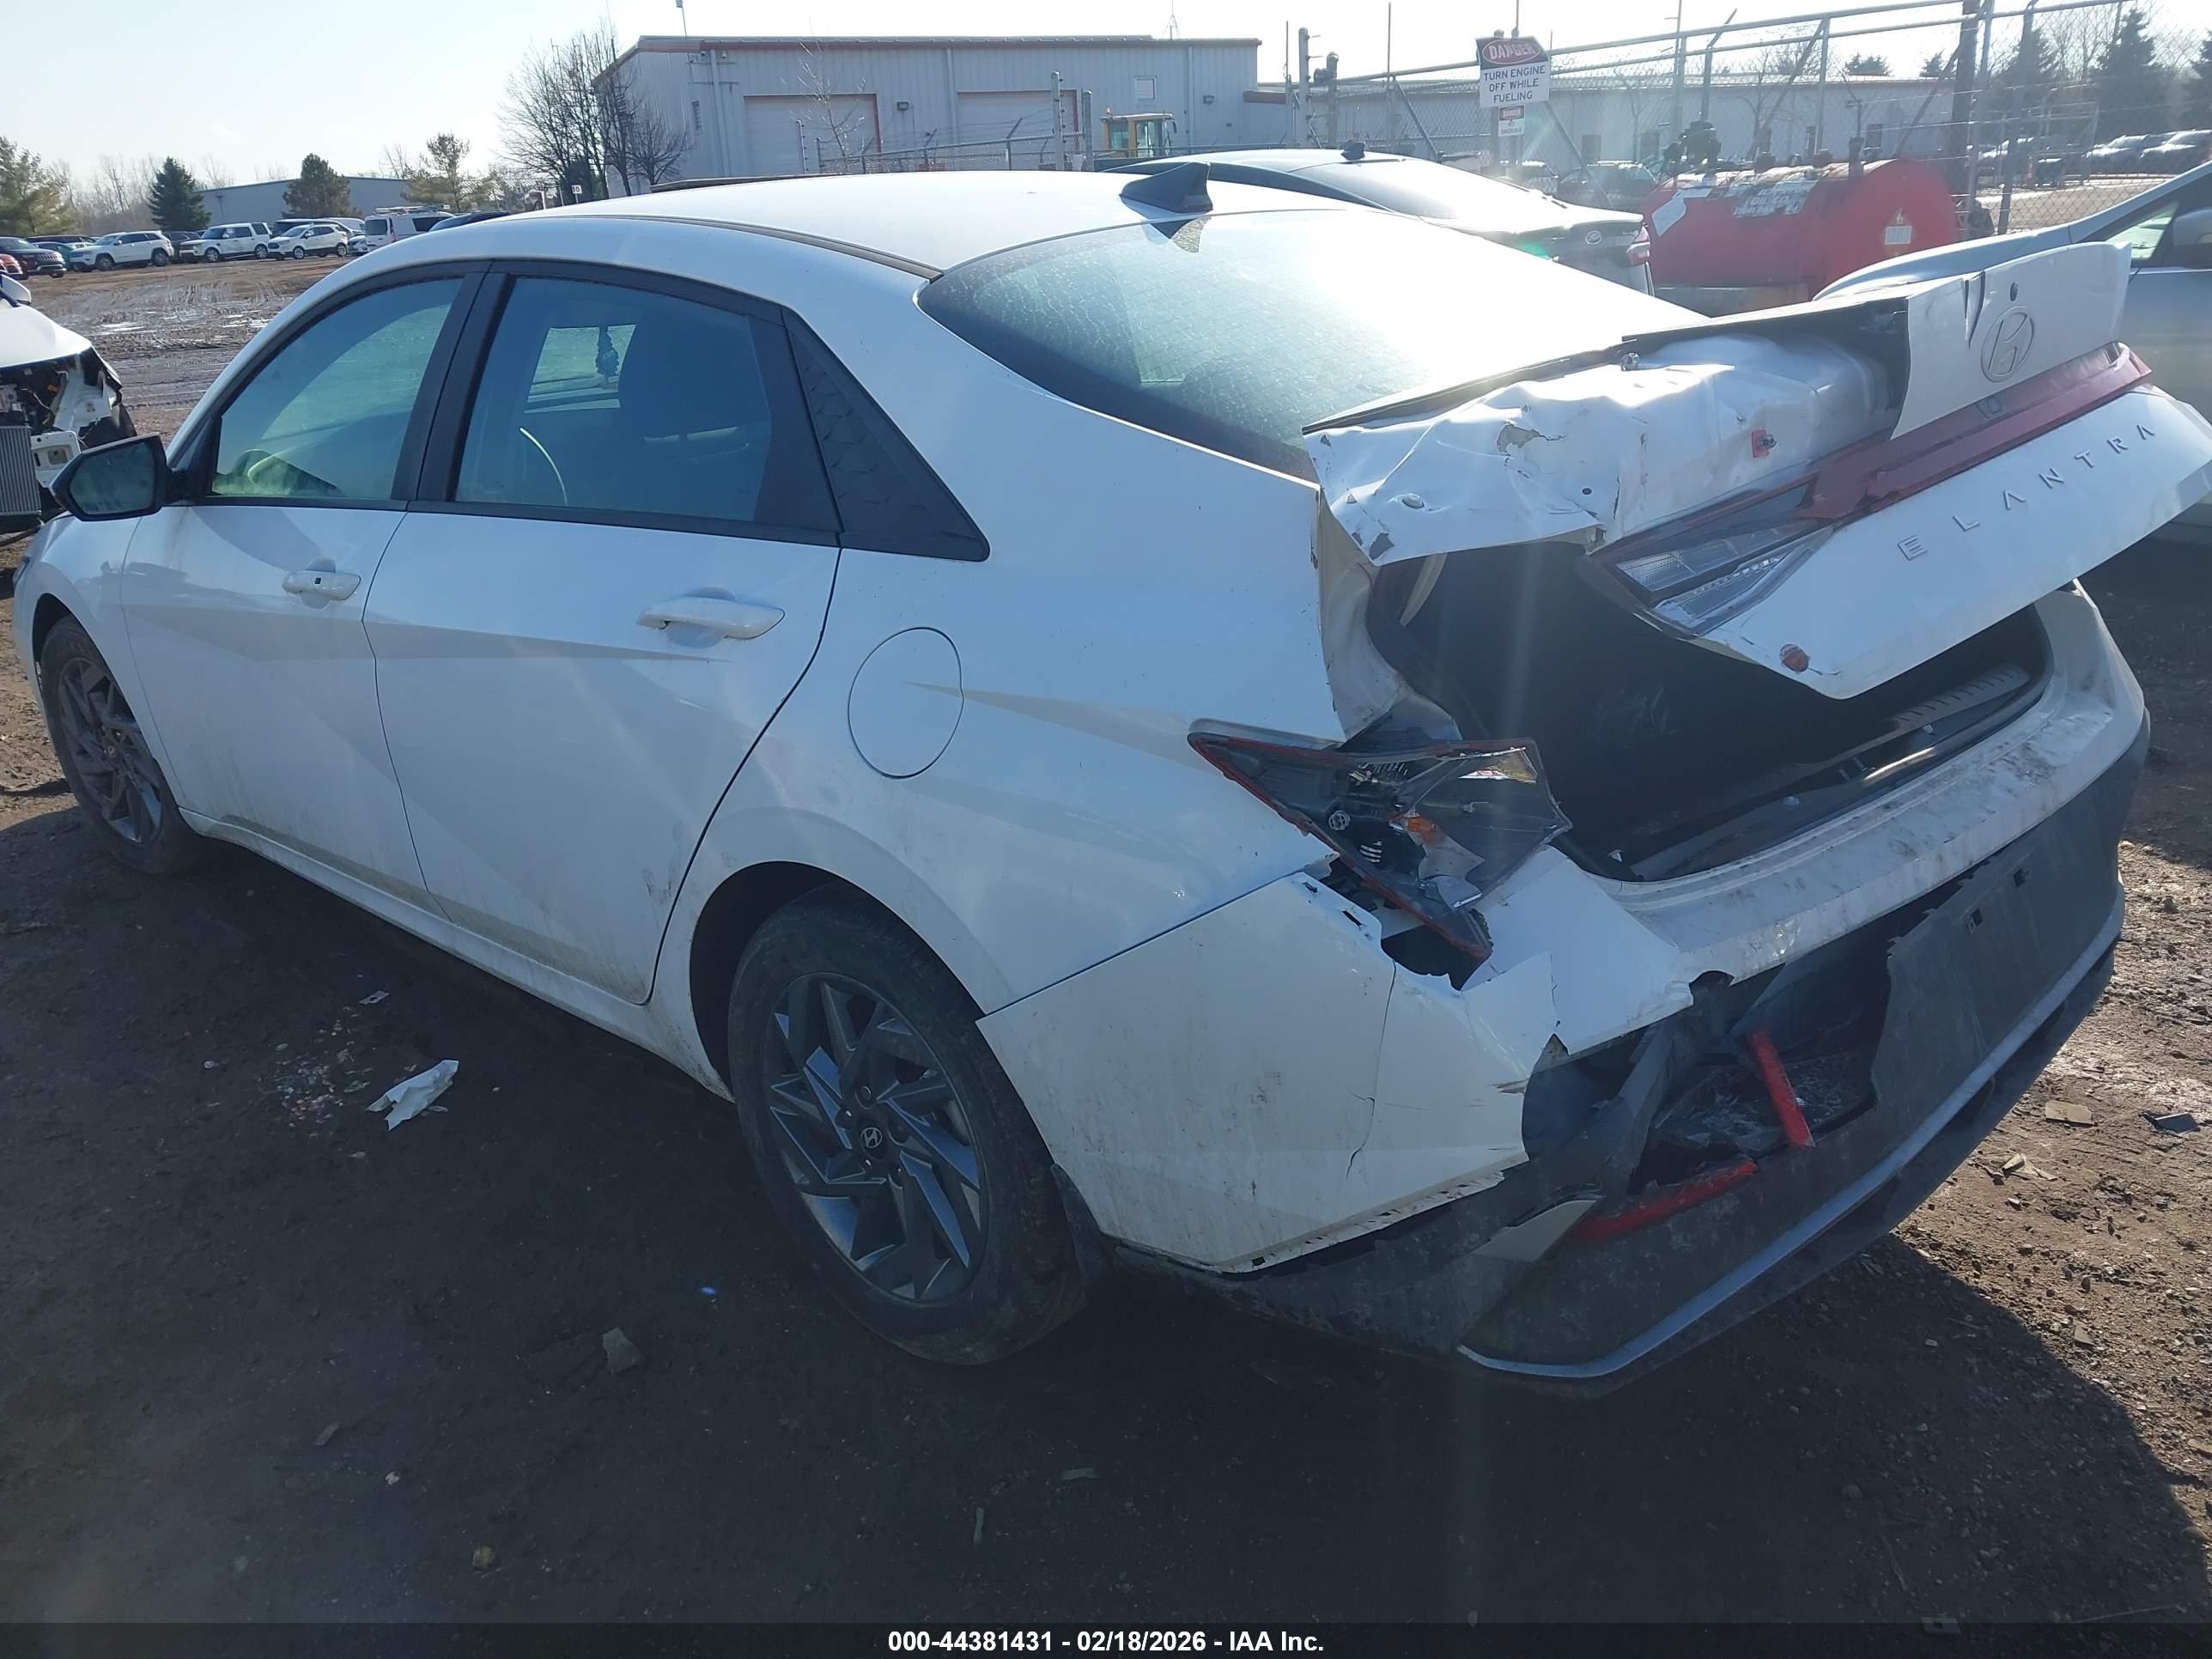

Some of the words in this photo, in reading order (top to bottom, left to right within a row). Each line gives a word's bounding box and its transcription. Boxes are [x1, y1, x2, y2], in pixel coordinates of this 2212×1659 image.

[1489, 43, 1535, 60] DANGER
[1483, 70, 1508, 82] TURN
[1510, 65, 1546, 77] ENGINE
[1489, 82, 1506, 92] OFF
[1510, 78, 1539, 89] WHILE
[1493, 91, 1533, 103] FUELING
[1897, 423, 2155, 562] ELANTRA
